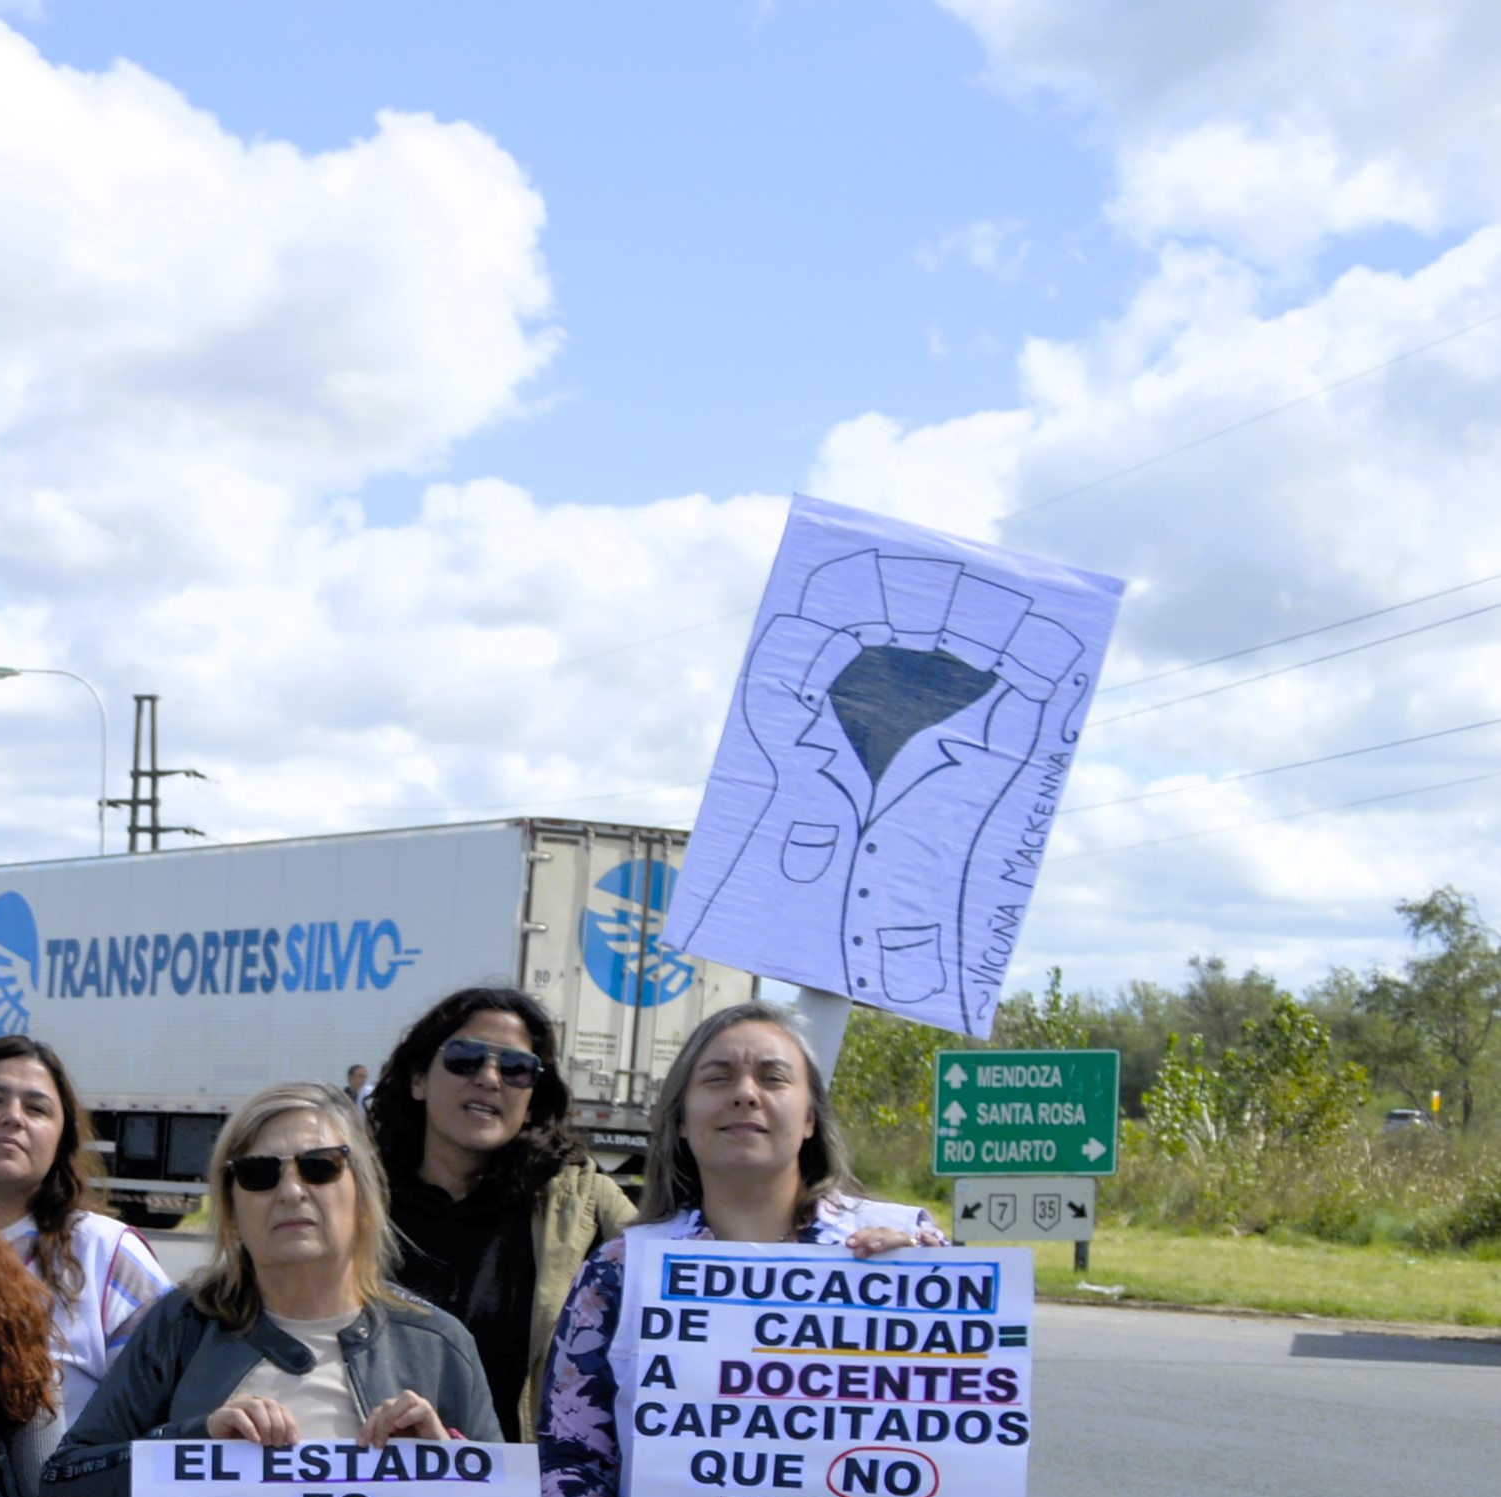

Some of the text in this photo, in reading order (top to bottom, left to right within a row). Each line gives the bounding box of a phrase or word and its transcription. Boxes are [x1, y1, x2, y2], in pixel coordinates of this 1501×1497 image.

[1000, 751, 1069, 889] MACKENNA
[976, 1065, 1062, 1088] MENDOZA
[976, 1102, 1086, 1125] SANTA ROSA
[943, 1140, 1057, 1163] RIO CUARTO
[997, 1202, 1009, 1221] 7
[1038, 1201, 1057, 1220] 35
[667, 1262, 994, 1311] EDUCACIÓN
[640, 1308, 709, 1343] DE
[640, 1354, 1019, 1404] A DOCENTES
[634, 1402, 1030, 1446] CAPACITADOS
[174, 1444, 240, 1481] EL
[261, 1444, 493, 1482] ESTADO
[690, 1449, 922, 1497] QUE NO
